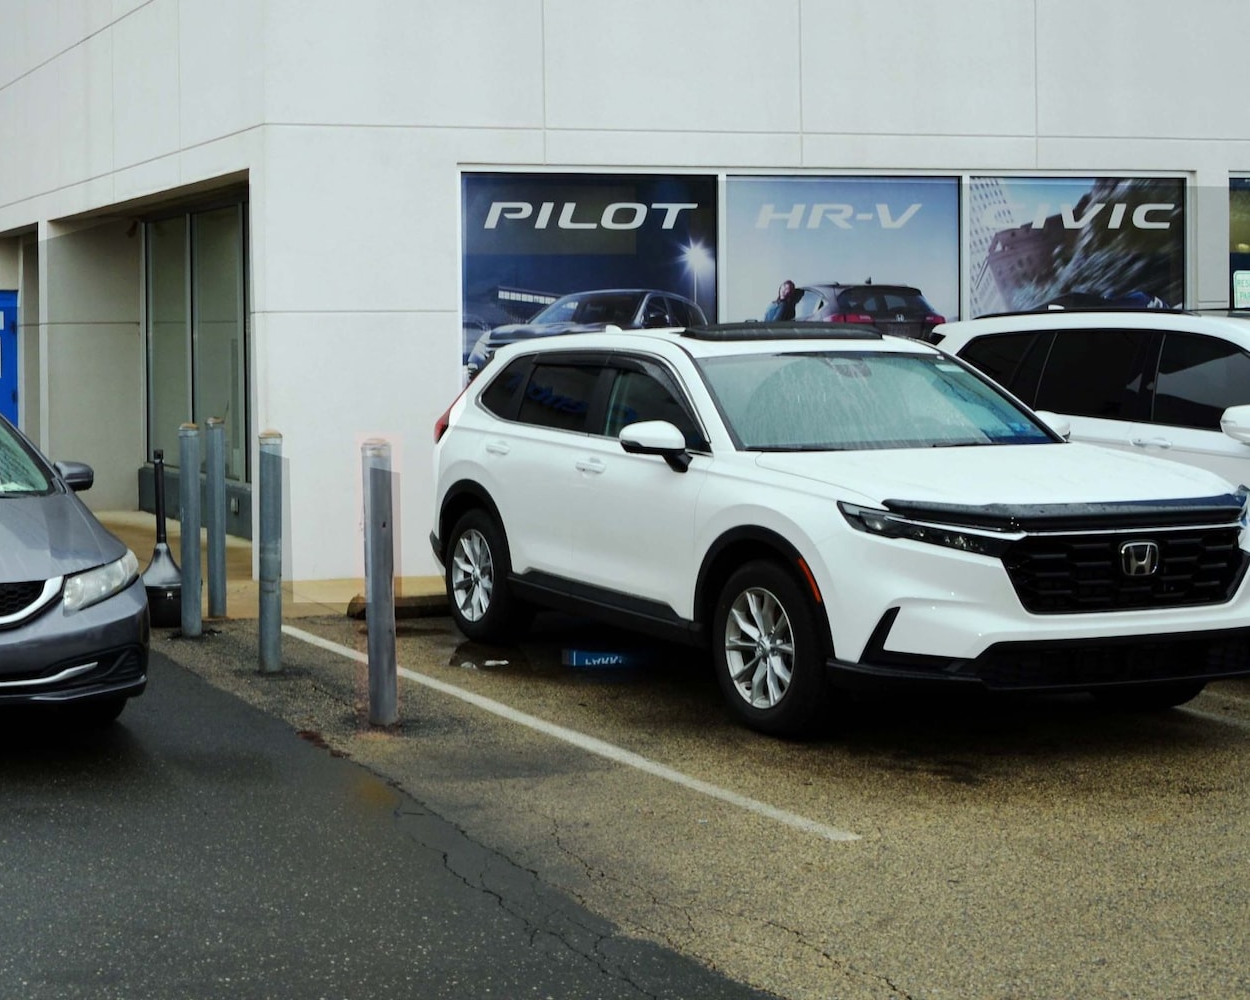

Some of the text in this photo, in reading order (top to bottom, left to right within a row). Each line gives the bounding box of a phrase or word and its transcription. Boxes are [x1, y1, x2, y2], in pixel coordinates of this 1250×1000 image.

[484, 201, 698, 231] PILOT
[756, 202, 923, 230] HR-V
[985, 202, 1176, 230] CIVIC
